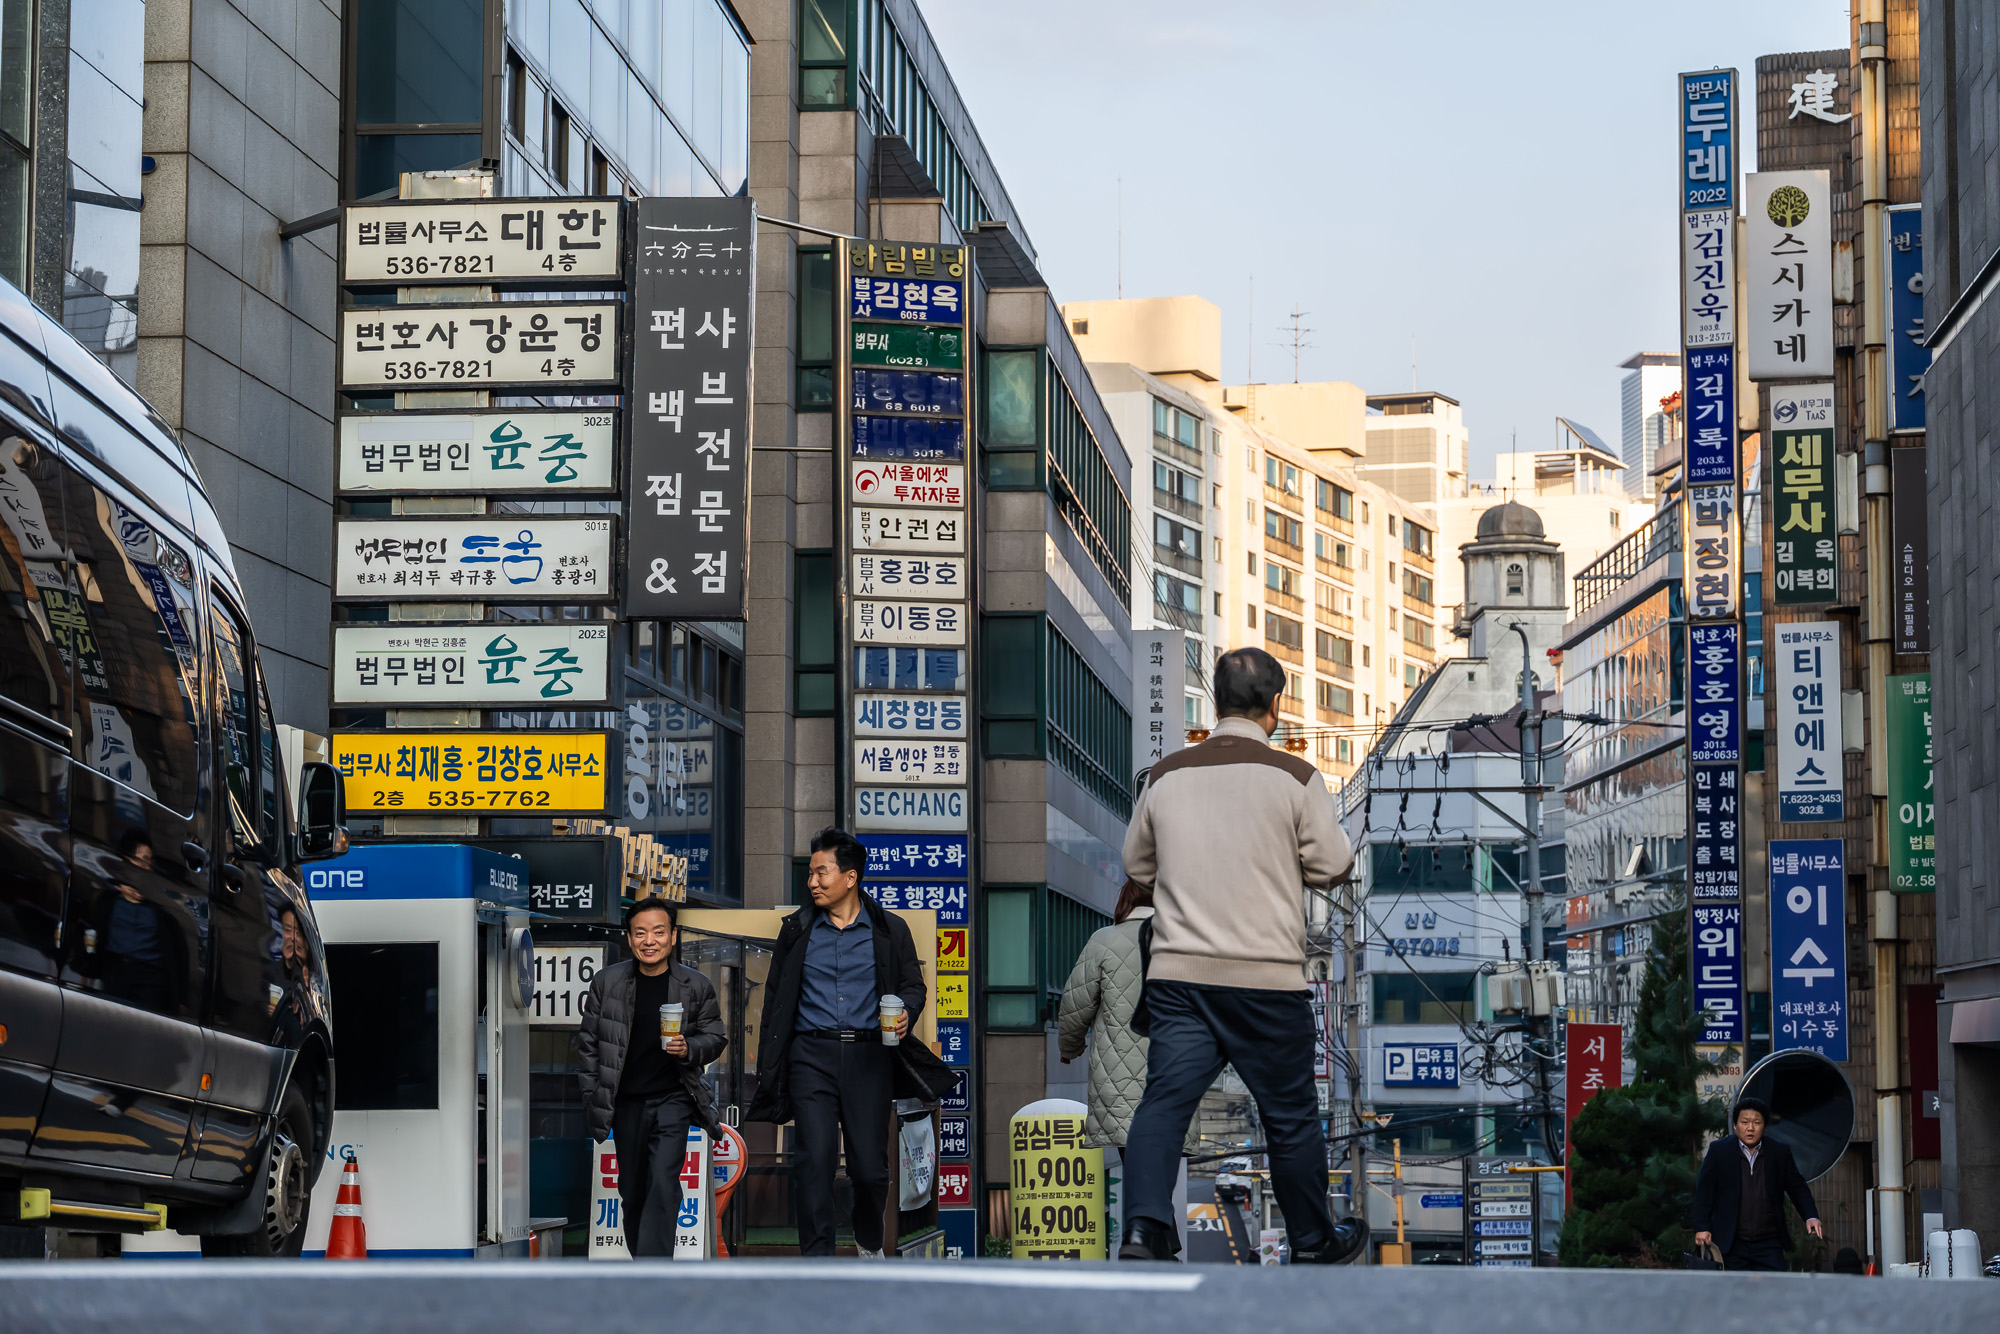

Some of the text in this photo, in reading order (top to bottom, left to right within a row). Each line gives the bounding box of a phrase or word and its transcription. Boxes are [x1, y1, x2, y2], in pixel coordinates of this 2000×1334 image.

[1686, 79, 1729, 101] 법무사
[1787, 69, 1852, 124] 建
[1686, 102, 1728, 183] 두레
[1689, 187, 1727, 205] 202호
[1687, 212, 1729, 228] 법무사
[358, 208, 607, 251] 법률사무소 대한
[644, 241, 742, 259] 六分三十
[386, 253, 577, 275] 536-7821 4층
[850, 243, 964, 277] 하림빌딩
[1692, 228, 1728, 322] 김진욱
[855, 277, 958, 316] 법무사 김현옥
[1770, 233, 1811, 363] 스시카네
[900, 311, 927, 320] 605호
[356, 312, 603, 353] 변호사 강윤경
[1699, 323, 1721, 332] 303호
[855, 332, 889, 351] 법무사
[1688, 332, 1731, 343] 313-2577
[384, 357, 576, 380] 536-7821 4층
[1691, 354, 1729, 368] 법무사
[910, 403, 941, 413] 601호
[1693, 373, 1728, 450] 김기록
[583, 415, 612, 427] 302호
[361, 419, 588, 484] 법무법인 윤중
[1697, 456, 1725, 465] 203호
[882, 465, 948, 483] 서울에셋
[1691, 467, 1731, 477] 535-3303
[1692, 486, 1733, 500] 변호사
[1779, 435, 1826, 533] 세무사
[894, 486, 961, 503] 투자자문
[584, 521, 609, 532] 301호
[861, 511, 956, 546] 법무사 안권섭
[355, 529, 544, 585] 법무법인 도움
[558, 554, 589, 567] 변호사
[1695, 501, 1733, 606] 박정현
[1903, 543, 1914, 586] 스튜디오
[357, 568, 497, 586] 변호사 최석두 곽규홍
[550, 568, 597, 586] 홍광의
[860, 558, 957, 594] 법무사 홍광호
[1776, 568, 1834, 591] 이복희
[860, 603, 957, 640] 법무사 이동윤
[388, 638, 410, 648] 변호사
[414, 637, 439, 648] 박현근
[578, 628, 607, 640] 202호
[1692, 627, 1737, 644] 변호사
[1781, 631, 1834, 644] 법률사무소
[355, 633, 583, 698] 법무법인 윤중
[1694, 646, 1734, 739] 홍호영
[1902, 681, 1931, 695] 법률
[858, 700, 962, 731] 세창합동
[1792, 646, 1827, 785] 티앤에스
[1150, 721, 1163, 760] 담아서
[1703, 741, 1727, 749] 301호
[861, 747, 927, 773] 서울생약
[932, 745, 960, 759] 협동
[1692, 750, 1738, 760] 508-0635
[339, 752, 391, 778] 법무사
[547, 752, 601, 778] 사무소
[932, 761, 960, 775] 조합
[373, 790, 550, 807] 2층 535-7762
[859, 791, 961, 817] SECHANG
[1798, 805, 1824, 815] 302호
[865, 844, 966, 868] 무법인 무궁화
[1772, 853, 1841, 875] 법률사무소
[868, 863, 891, 872] 205호
[1694, 871, 1738, 883] 천일기획
[531, 884, 593, 908] 전문점
[904, 885, 967, 910] 행정사
[1694, 885, 1738, 897] 02.594.3555
[941, 911, 962, 920] 301호
[1694, 908, 1740, 924] 행정사
[1783, 885, 1835, 987] 이수
[1697, 928, 1738, 1027] 위드문
[1780, 1001, 1841, 1017] 대표변호사
[937, 1026, 961, 1036] 사무소
[1706, 1031, 1731, 1040] 501호
[1782, 1020, 1839, 1039] 이수동
[1430, 1050, 1454, 1063] 유료
[1417, 1066, 1456, 1080] 주차장
[596, 1236, 623, 1247] 법무사
